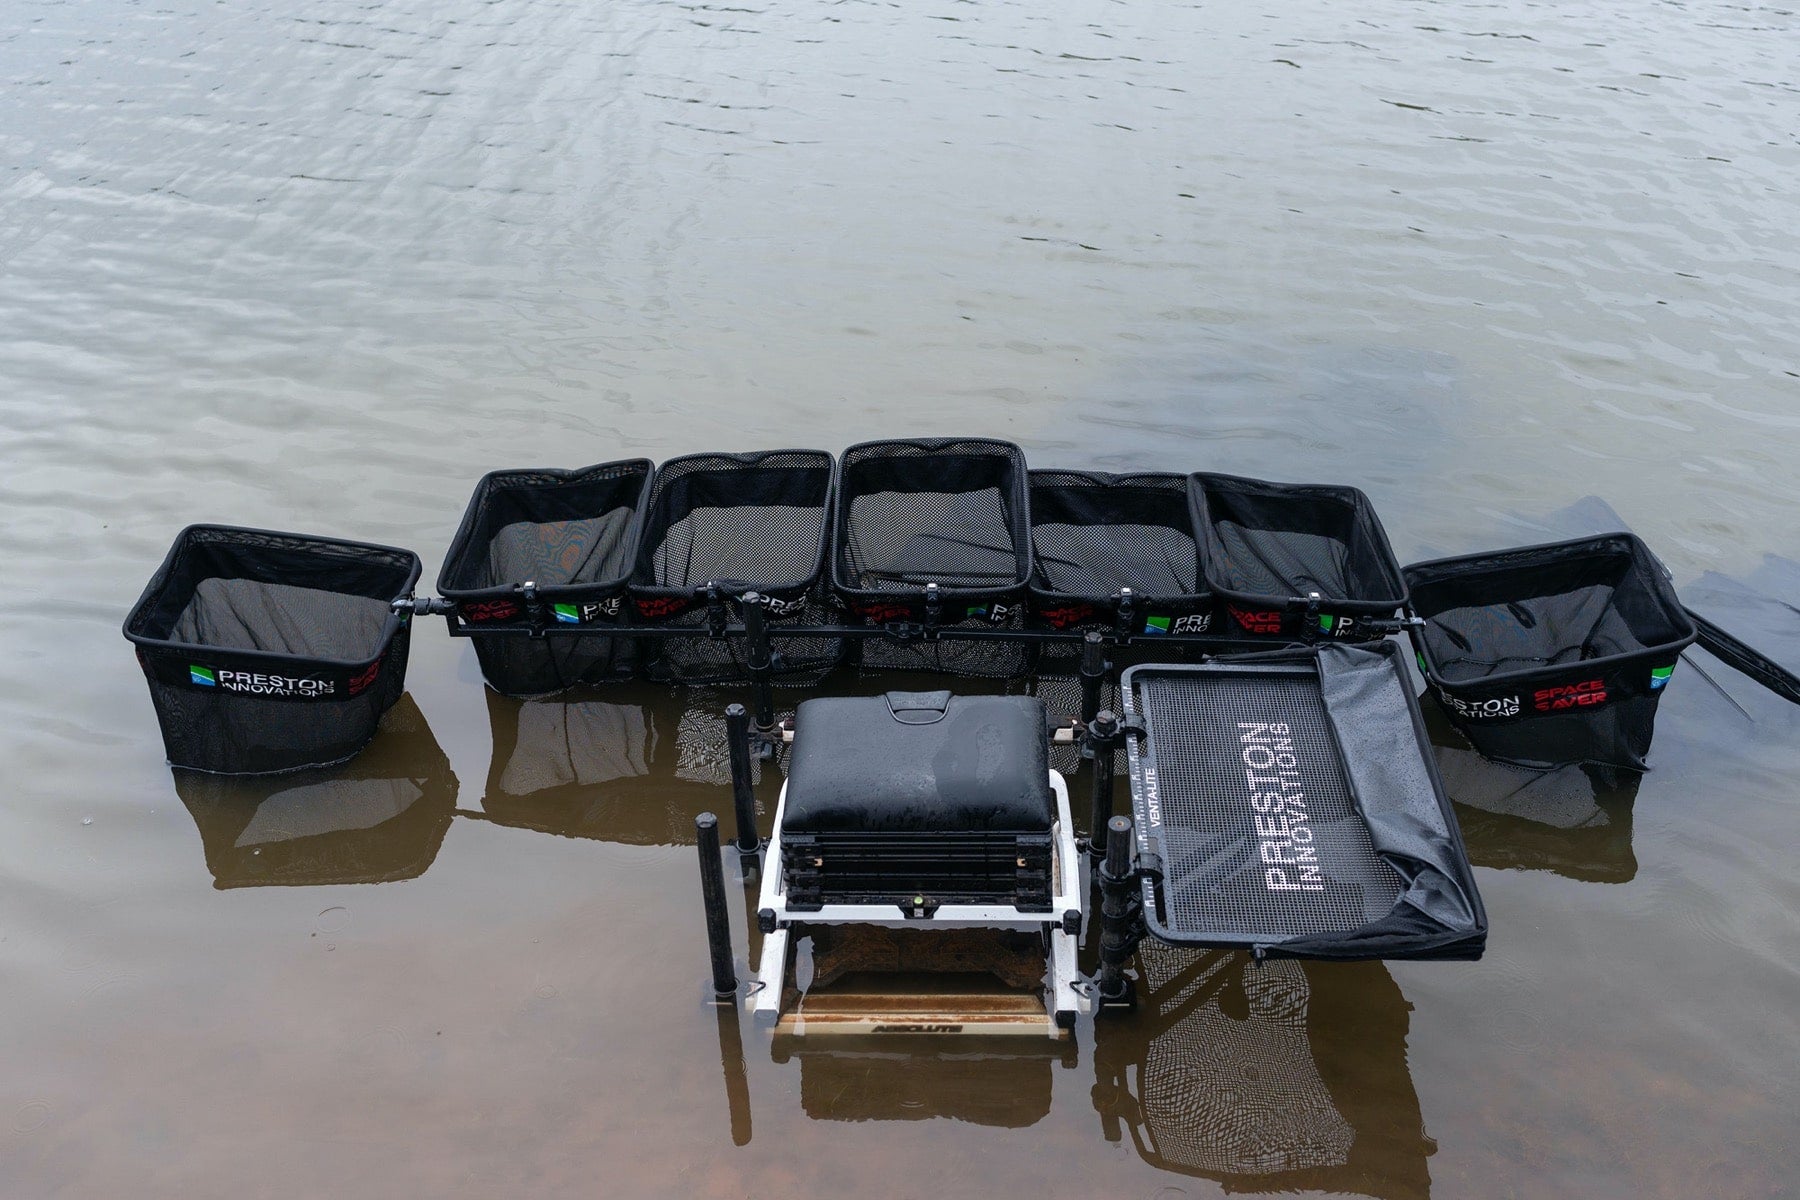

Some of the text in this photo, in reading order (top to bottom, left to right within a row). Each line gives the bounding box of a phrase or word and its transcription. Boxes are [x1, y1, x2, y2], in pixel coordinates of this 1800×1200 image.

[218, 670, 334, 691] PRESTON
[222, 682, 335, 698] INNOVATIONS
[1534, 679, 1605, 701] SPACE
[1534, 691, 1607, 711] SAVER
[1145, 767, 1161, 828] VENTA-LITE
[1238, 722, 1301, 890] PRESTON
[1270, 722, 1325, 890] INNOVATIONS
[871, 1025, 963, 1033] ABSOLUTE
